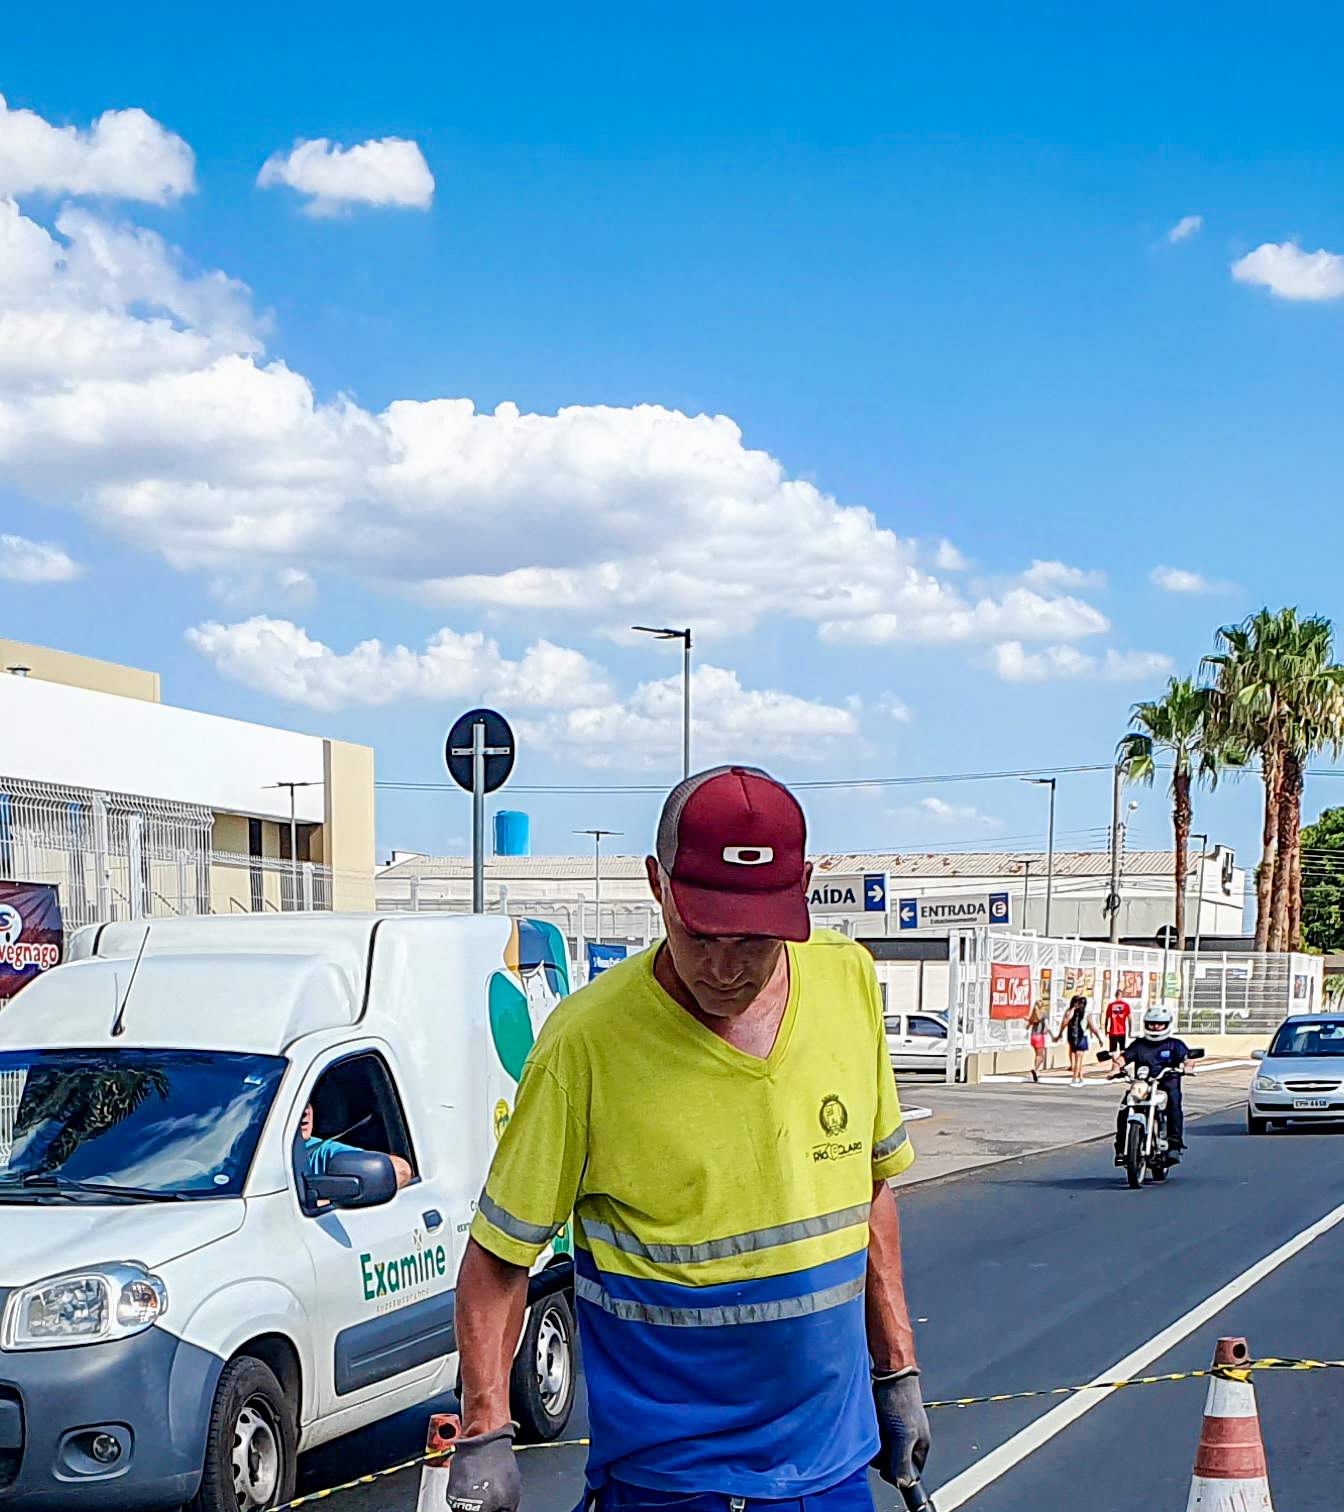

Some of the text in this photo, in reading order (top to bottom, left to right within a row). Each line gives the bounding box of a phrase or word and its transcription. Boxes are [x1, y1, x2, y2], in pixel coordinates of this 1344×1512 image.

[805, 885, 856, 905] AÍDA
[921, 903, 987, 918] ENTRADA
[360, 1244, 446, 1301] Examine
